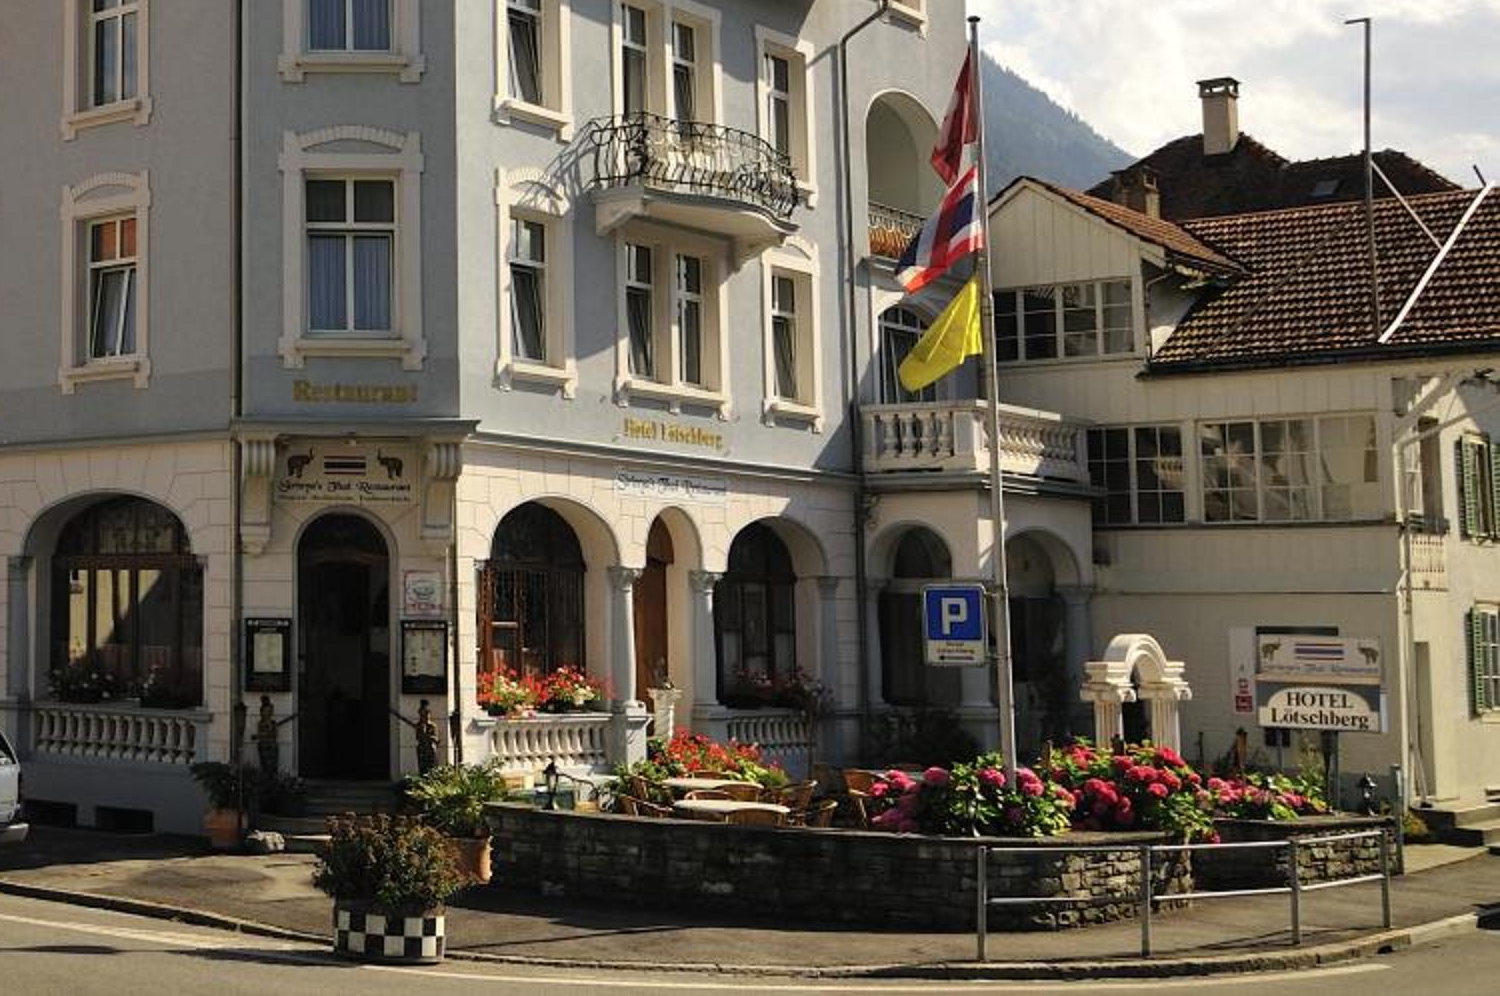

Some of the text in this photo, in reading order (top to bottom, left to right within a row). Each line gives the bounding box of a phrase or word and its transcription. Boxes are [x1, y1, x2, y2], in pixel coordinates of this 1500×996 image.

[624, 417, 657, 438] Hotel
[942, 597, 967, 635] P
[1287, 692, 1354, 709] HOTEL
[1271, 708, 1369, 729] Lötschberg
